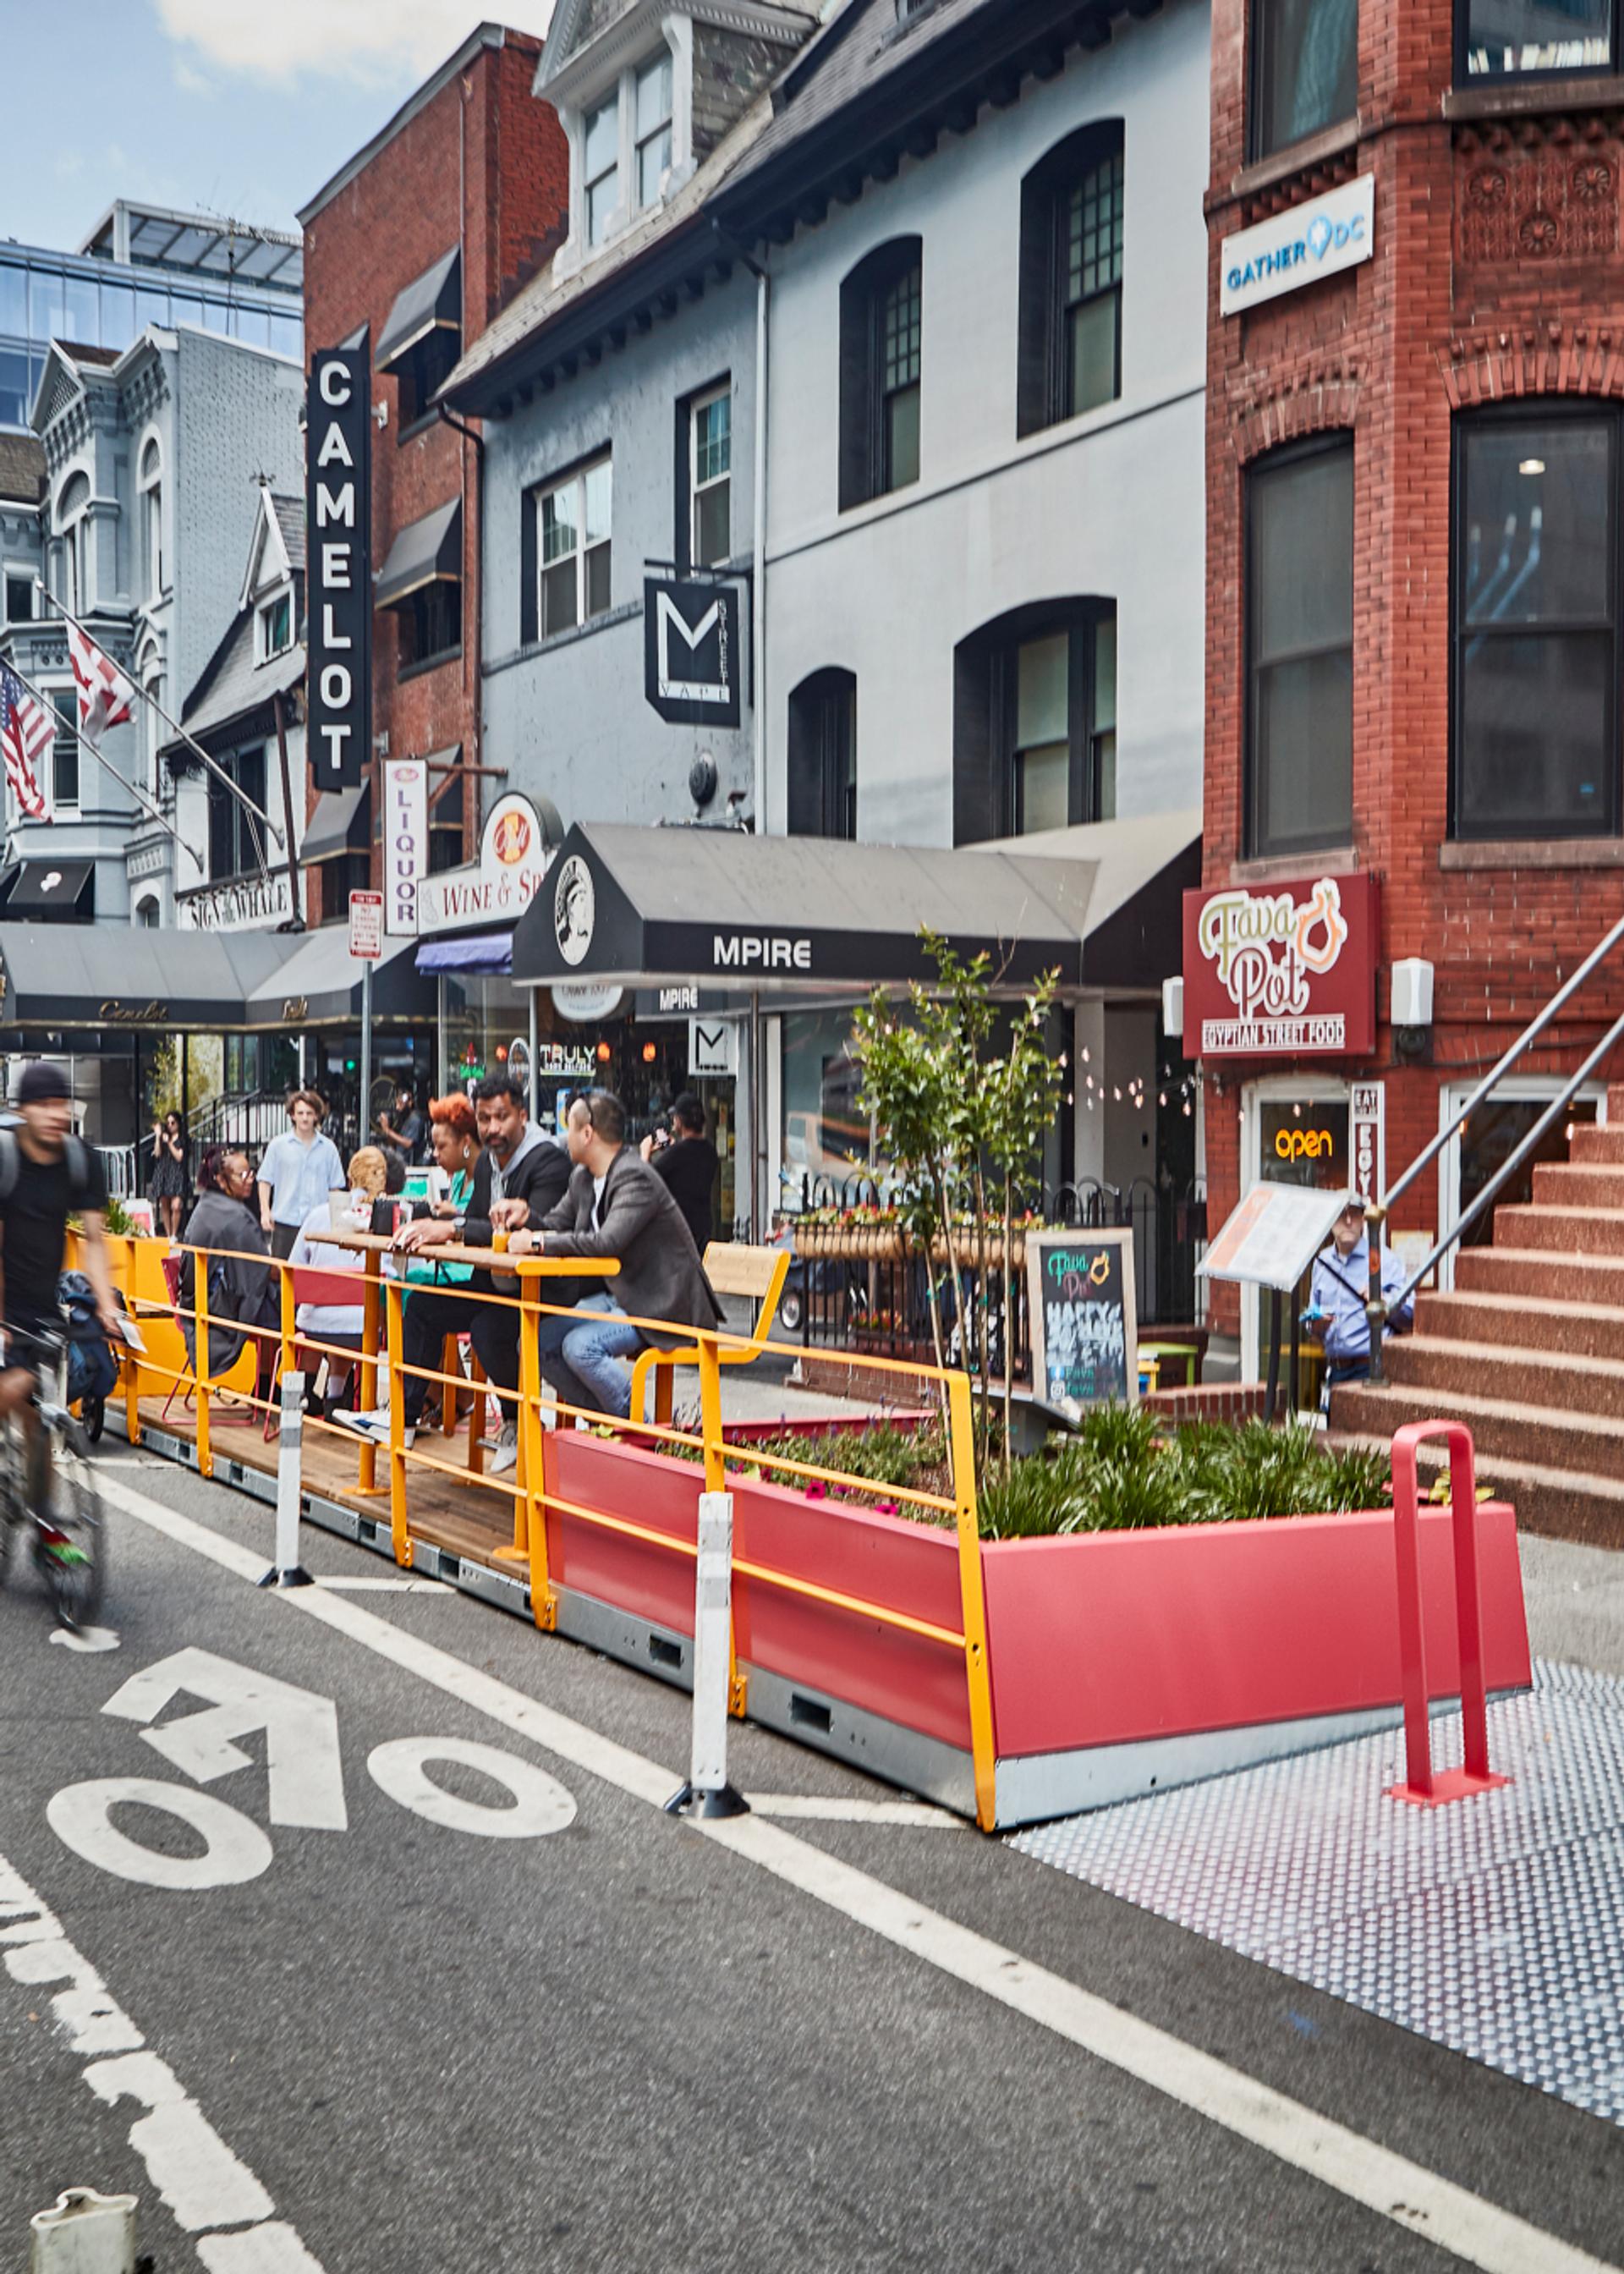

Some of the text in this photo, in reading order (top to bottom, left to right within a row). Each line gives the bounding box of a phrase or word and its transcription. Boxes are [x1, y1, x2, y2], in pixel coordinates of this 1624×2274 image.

[1227, 215, 1364, 289] GATHER DC
[315, 360, 354, 770] CAMELOT
[660, 683, 727, 702] VAPE
[396, 790, 415, 921] LIQUOR
[233, 883, 288, 920] WHALE
[443, 882, 492, 917] WINE
[498, 871, 512, 907] &
[713, 935, 812, 969] MPIRE
[1200, 891, 1298, 979] Fava
[1231, 941, 1308, 1020] Pot
[659, 987, 698, 1011] MPIRE
[1204, 1019, 1345, 1048] EGYPTIAN STREET FOOD
[540, 1043, 596, 1063] TRULY
[1354, 1089, 1377, 1106] EAT
[1275, 1129, 1333, 1163] open
